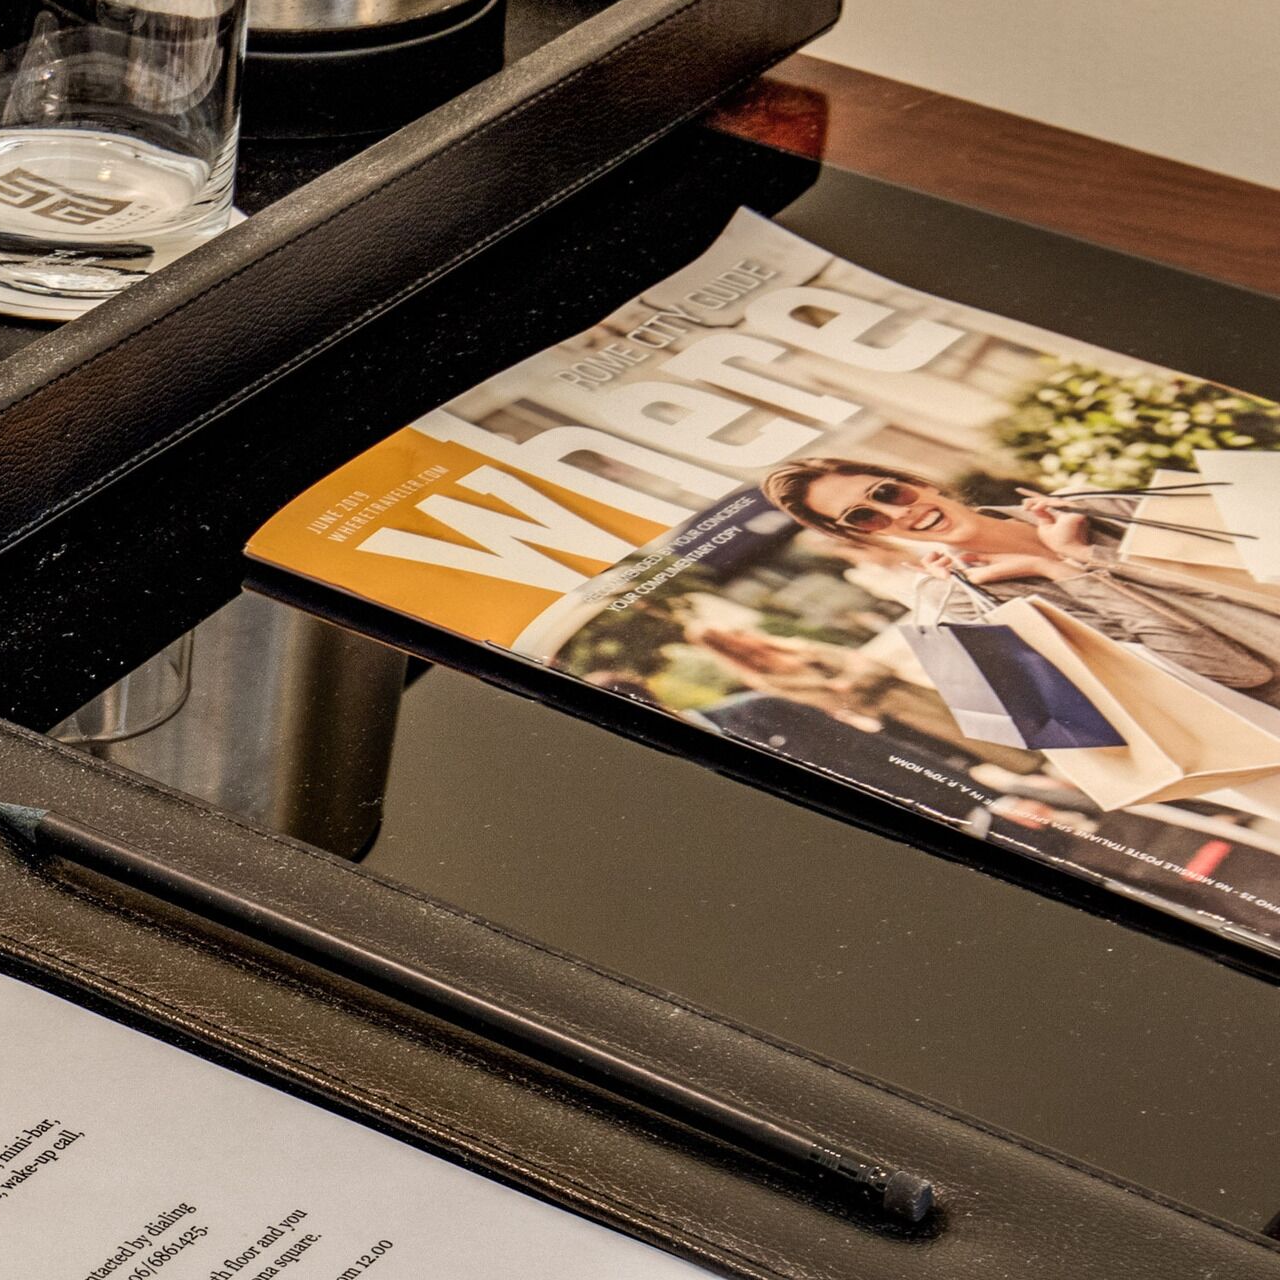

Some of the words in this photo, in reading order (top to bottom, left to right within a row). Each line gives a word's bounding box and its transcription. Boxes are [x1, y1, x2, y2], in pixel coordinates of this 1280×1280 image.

[555, 343, 650, 392] ROME
[626, 304, 703, 350] CITY
[683, 260, 778, 310] GUIDE
[355, 286, 965, 595] where
[306, 509, 344, 535] JUNE
[335, 490, 371, 512] 2019
[327, 464, 449, 543] WHERETRAVELER.COM
[659, 545, 676, 558] BY
[673, 527, 702, 548] YOUR
[696, 495, 758, 532] CONCIERGE
[605, 592, 640, 613] YOUR
[636, 541, 718, 595] COMPLIMENTARY
[711, 524, 744, 545] COPY
[888, 755, 925, 774] ROMA
[923, 768, 948, 783] 70%
[968, 790, 985, 801] IN
[1073, 830, 1127, 852] ITALIANE
[1125, 847, 1165, 867] POSTE
[1162, 861, 1216, 886] MENSILE
[0, 1149, 59, 1190] wake-up
[52, 1129, 86, 1151] call,
[123, 1234, 153, 1250] by
[144, 1202, 197, 1237] dialing
[223, 1246, 261, 1272] floor
[256, 1225, 286, 1248] and
[278, 1209, 308, 1232] you
[274, 1233, 322, 1268] square.
[355, 1239, 394, 1269] 12.00
